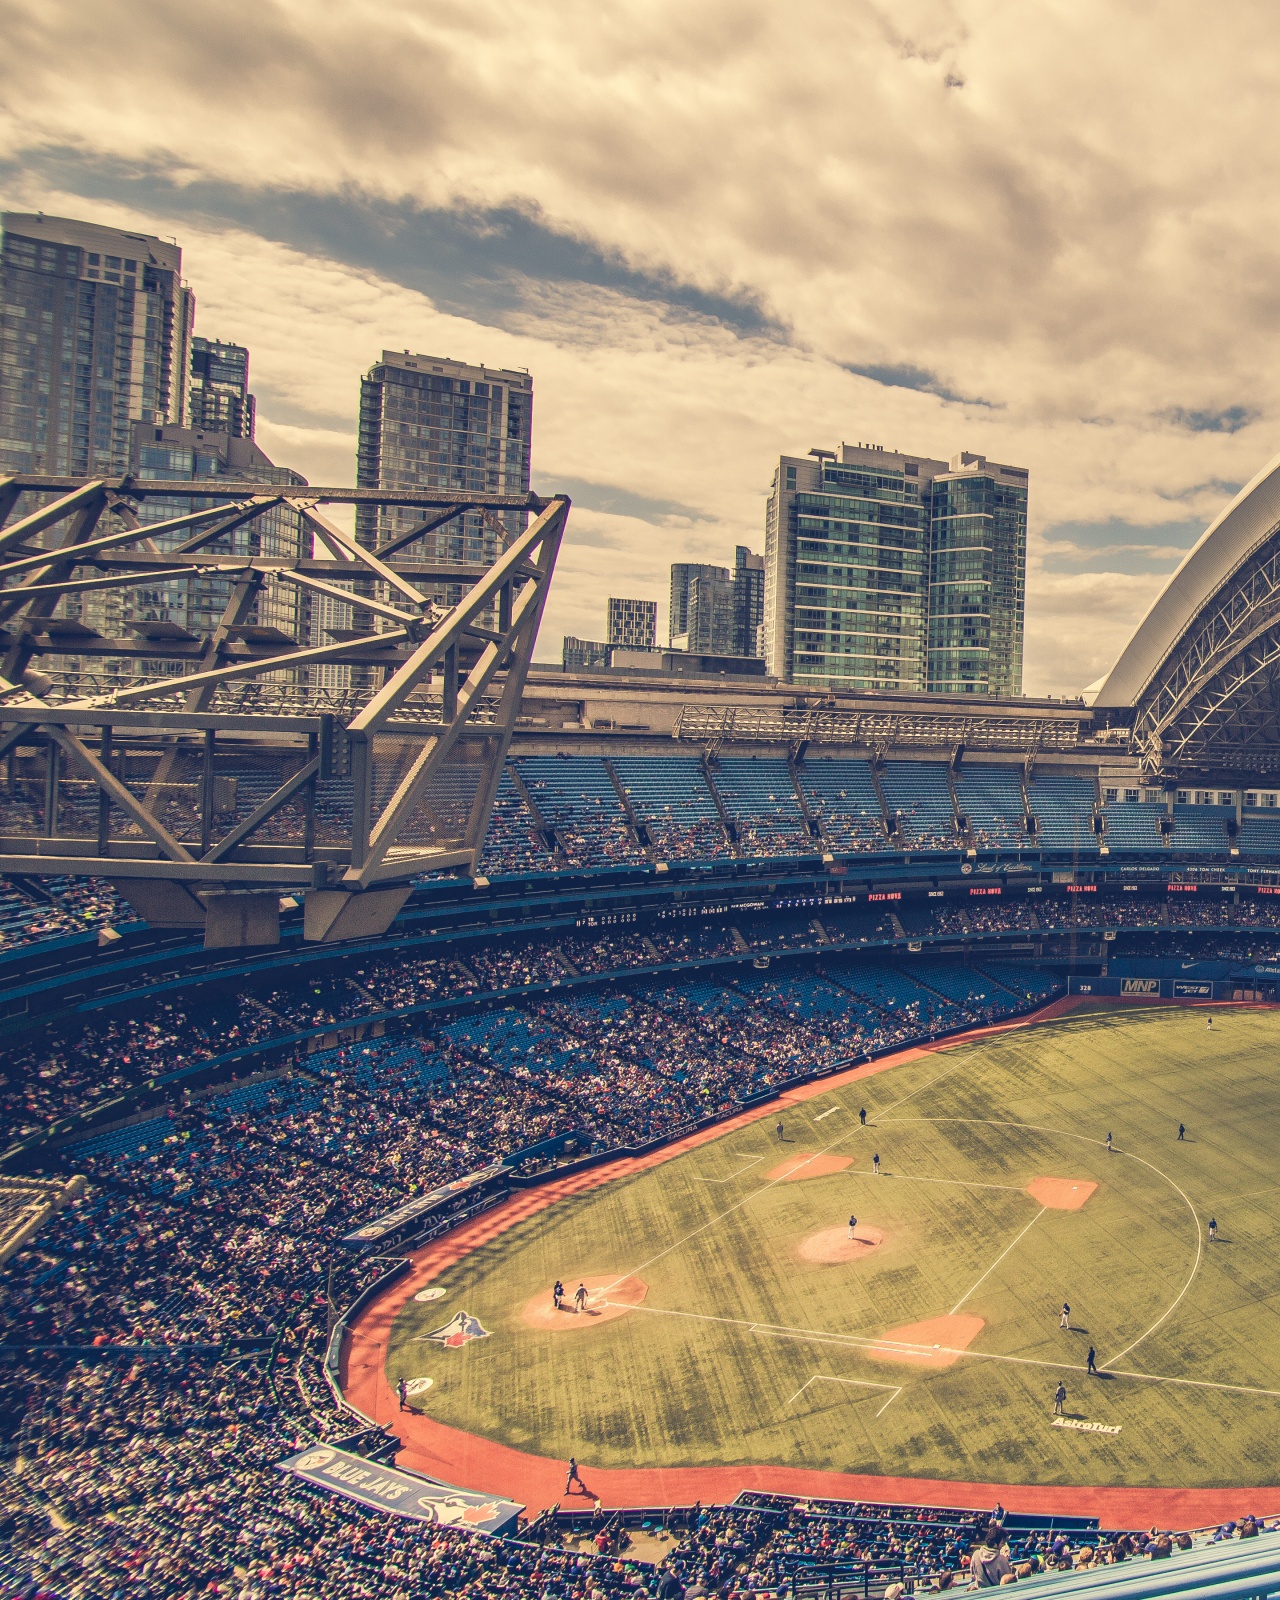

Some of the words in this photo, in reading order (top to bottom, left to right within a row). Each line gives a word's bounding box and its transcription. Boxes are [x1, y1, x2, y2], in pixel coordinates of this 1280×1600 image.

[969, 888, 987, 896] PIZZA
[1257, 886, 1273, 894] PIZZA
[868, 893, 886, 902] PIZZA
[1124, 980, 1157, 992] MNP
[720, 1105, 744, 1118] ACURA
[672, 1124, 698, 1139] ACURA
[1050, 1417, 1123, 1435] AstroTurf
[322, 1460, 372, 1485] BLUE
[359, 1474, 412, 1500] JAYS
